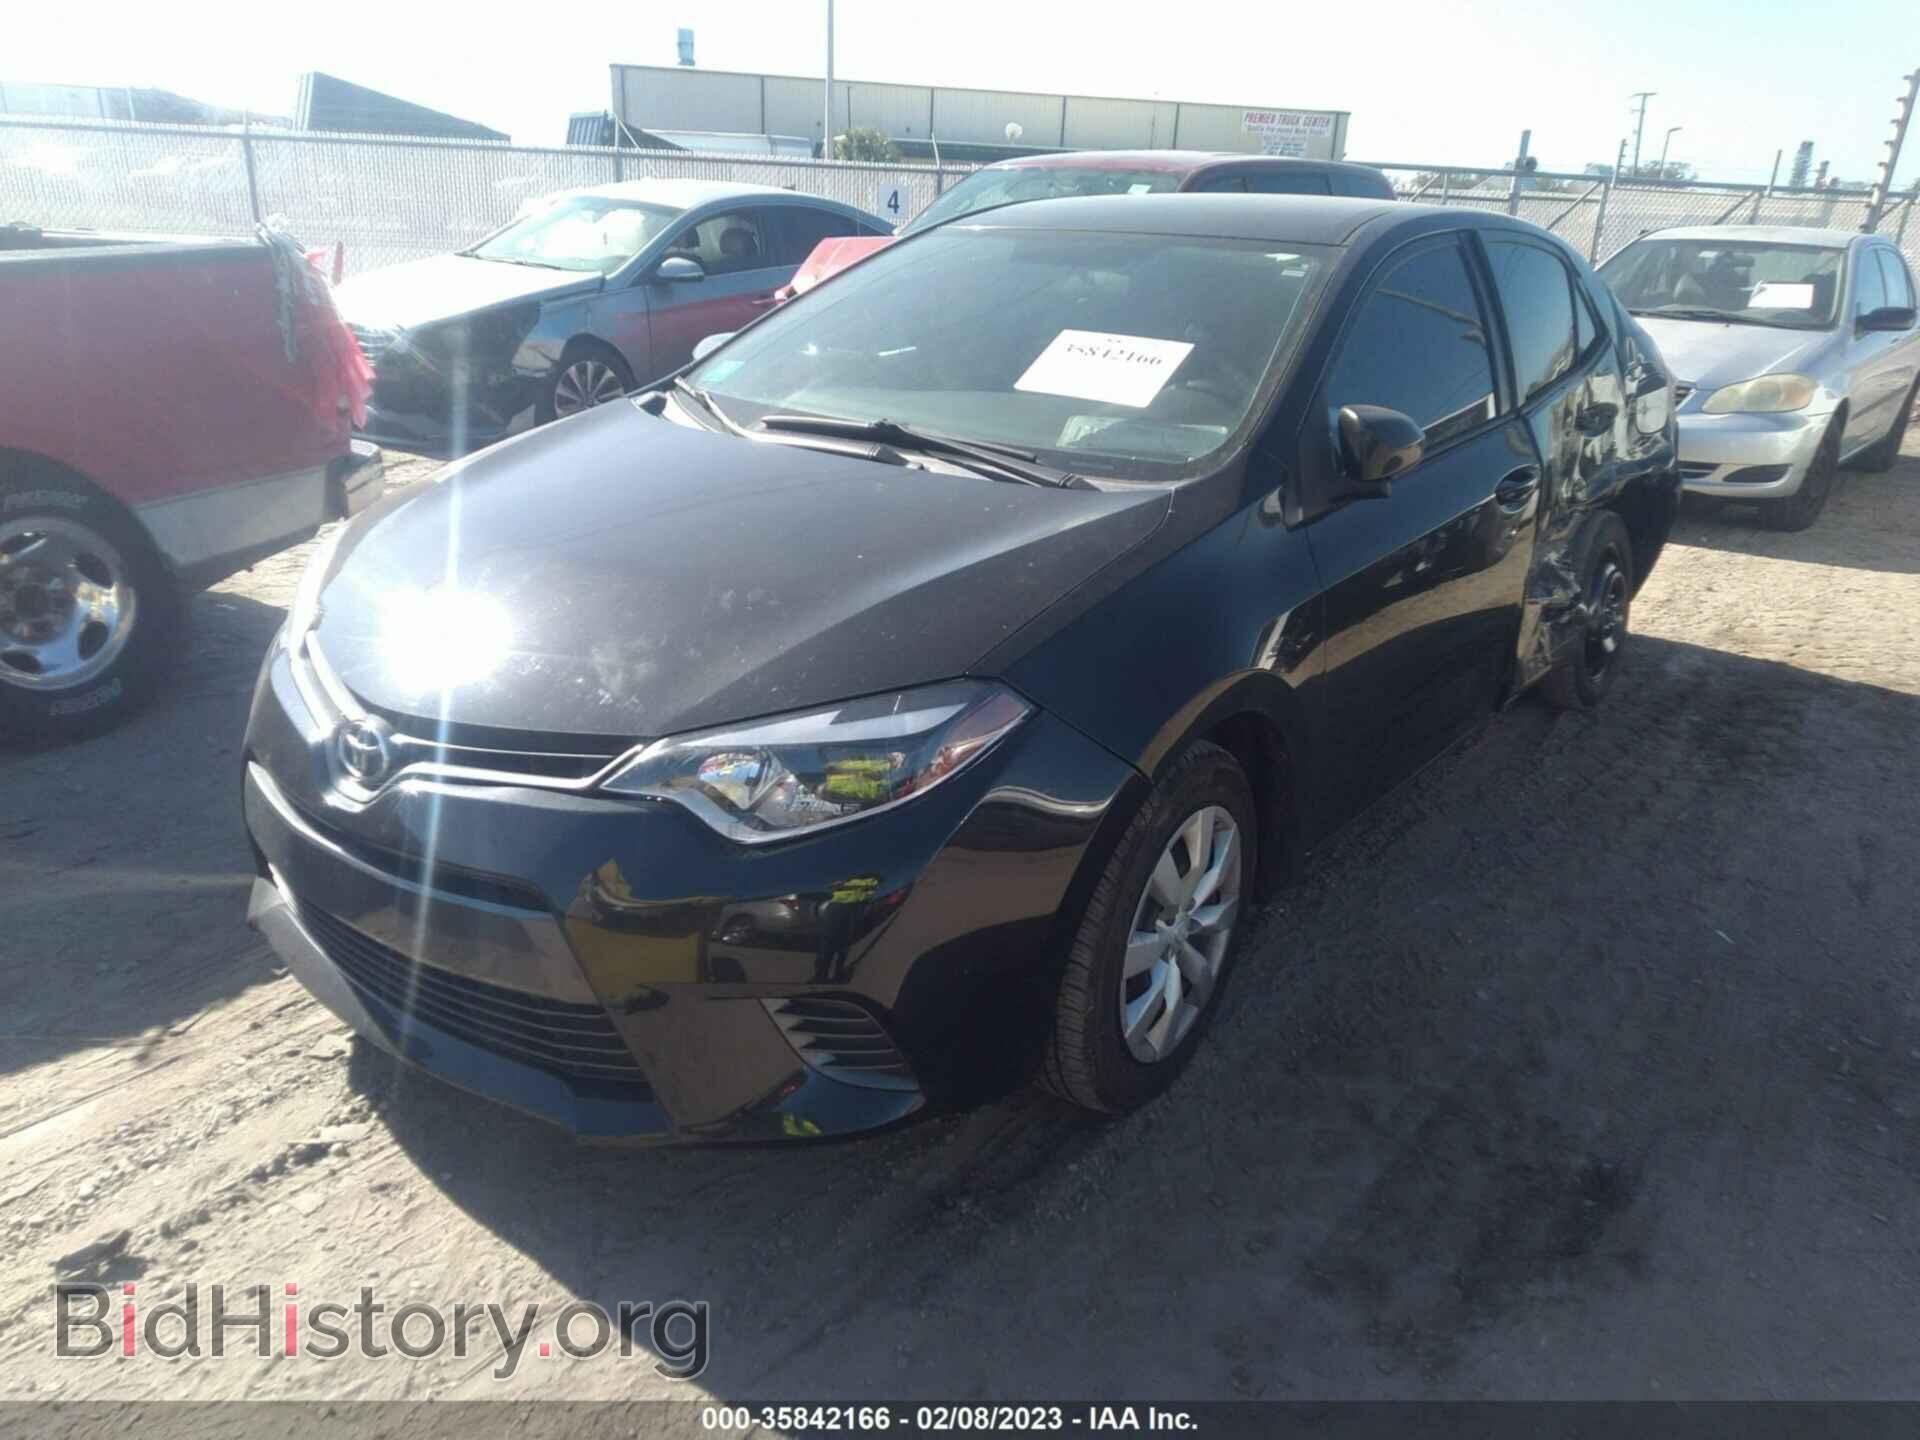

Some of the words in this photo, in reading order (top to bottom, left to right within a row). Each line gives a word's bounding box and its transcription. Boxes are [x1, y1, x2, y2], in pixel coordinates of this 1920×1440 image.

[1243, 111, 1277, 124] PREMIER
[1278, 113, 1301, 126] TRUCK
[1303, 114, 1331, 128] CENTER
[887, 189, 899, 214] 4
